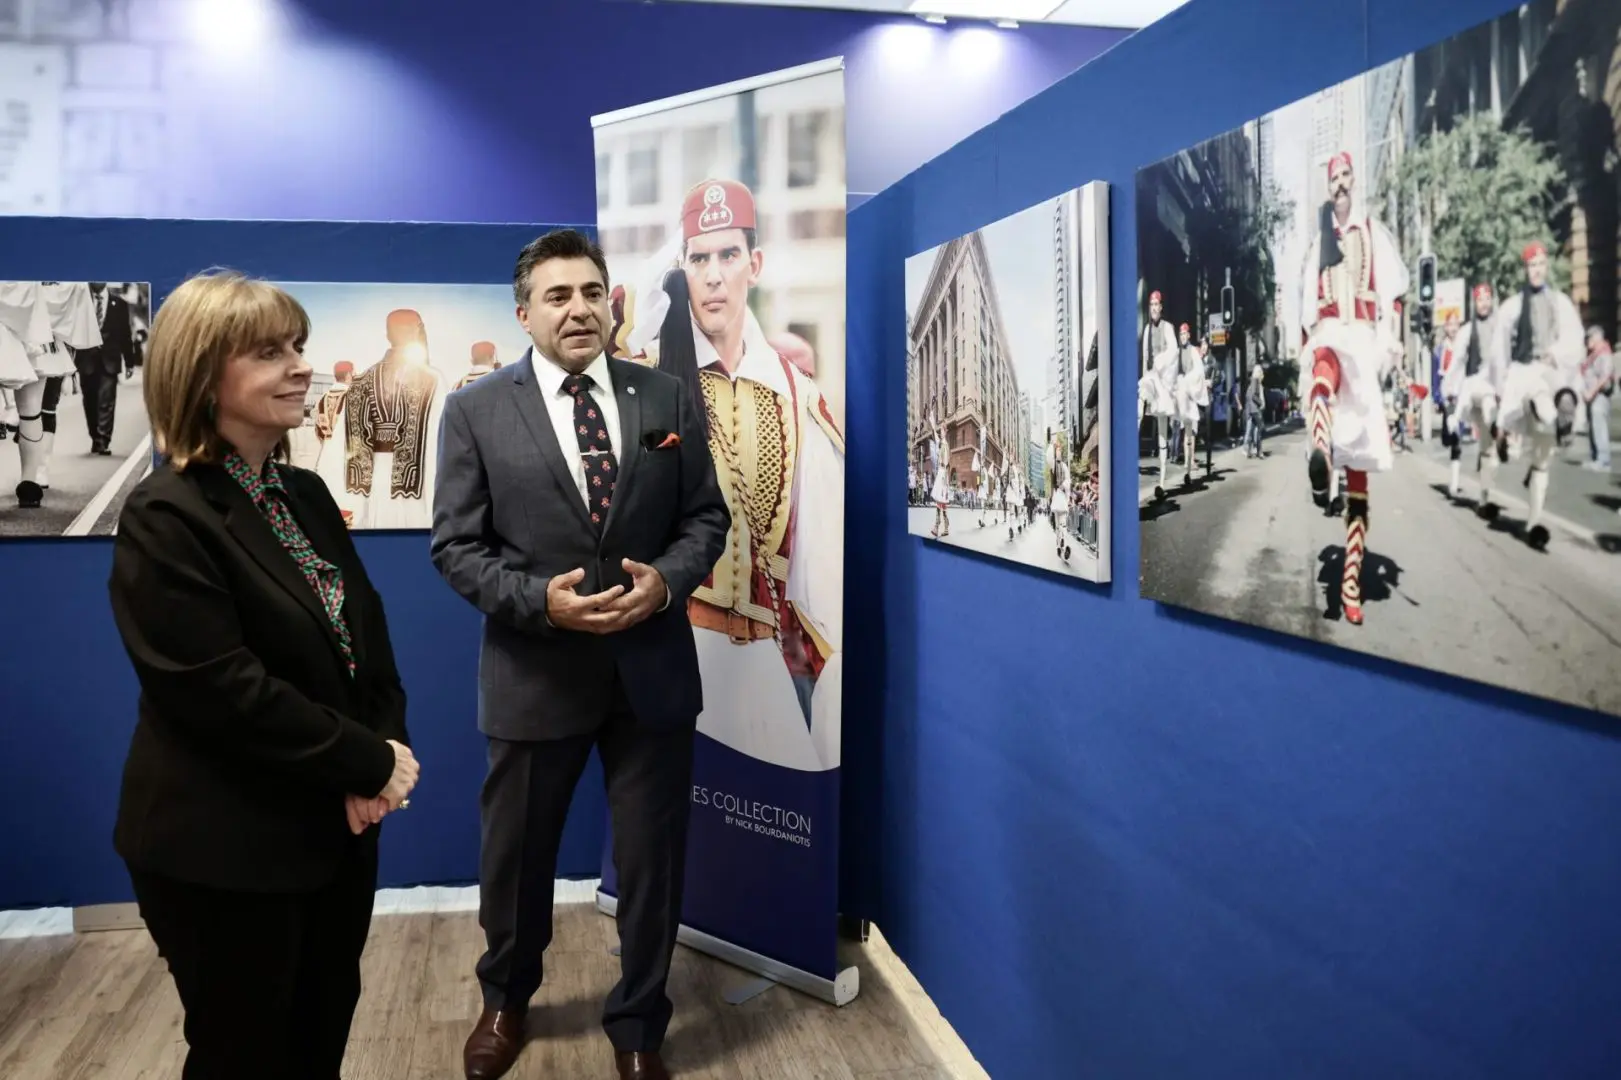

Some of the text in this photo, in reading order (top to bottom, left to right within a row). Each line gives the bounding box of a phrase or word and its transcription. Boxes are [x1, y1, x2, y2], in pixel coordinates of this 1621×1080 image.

[691, 785, 812, 835] ES COLLECTION
[725, 815, 811, 848] BY NICK BOURDANIOTIS
